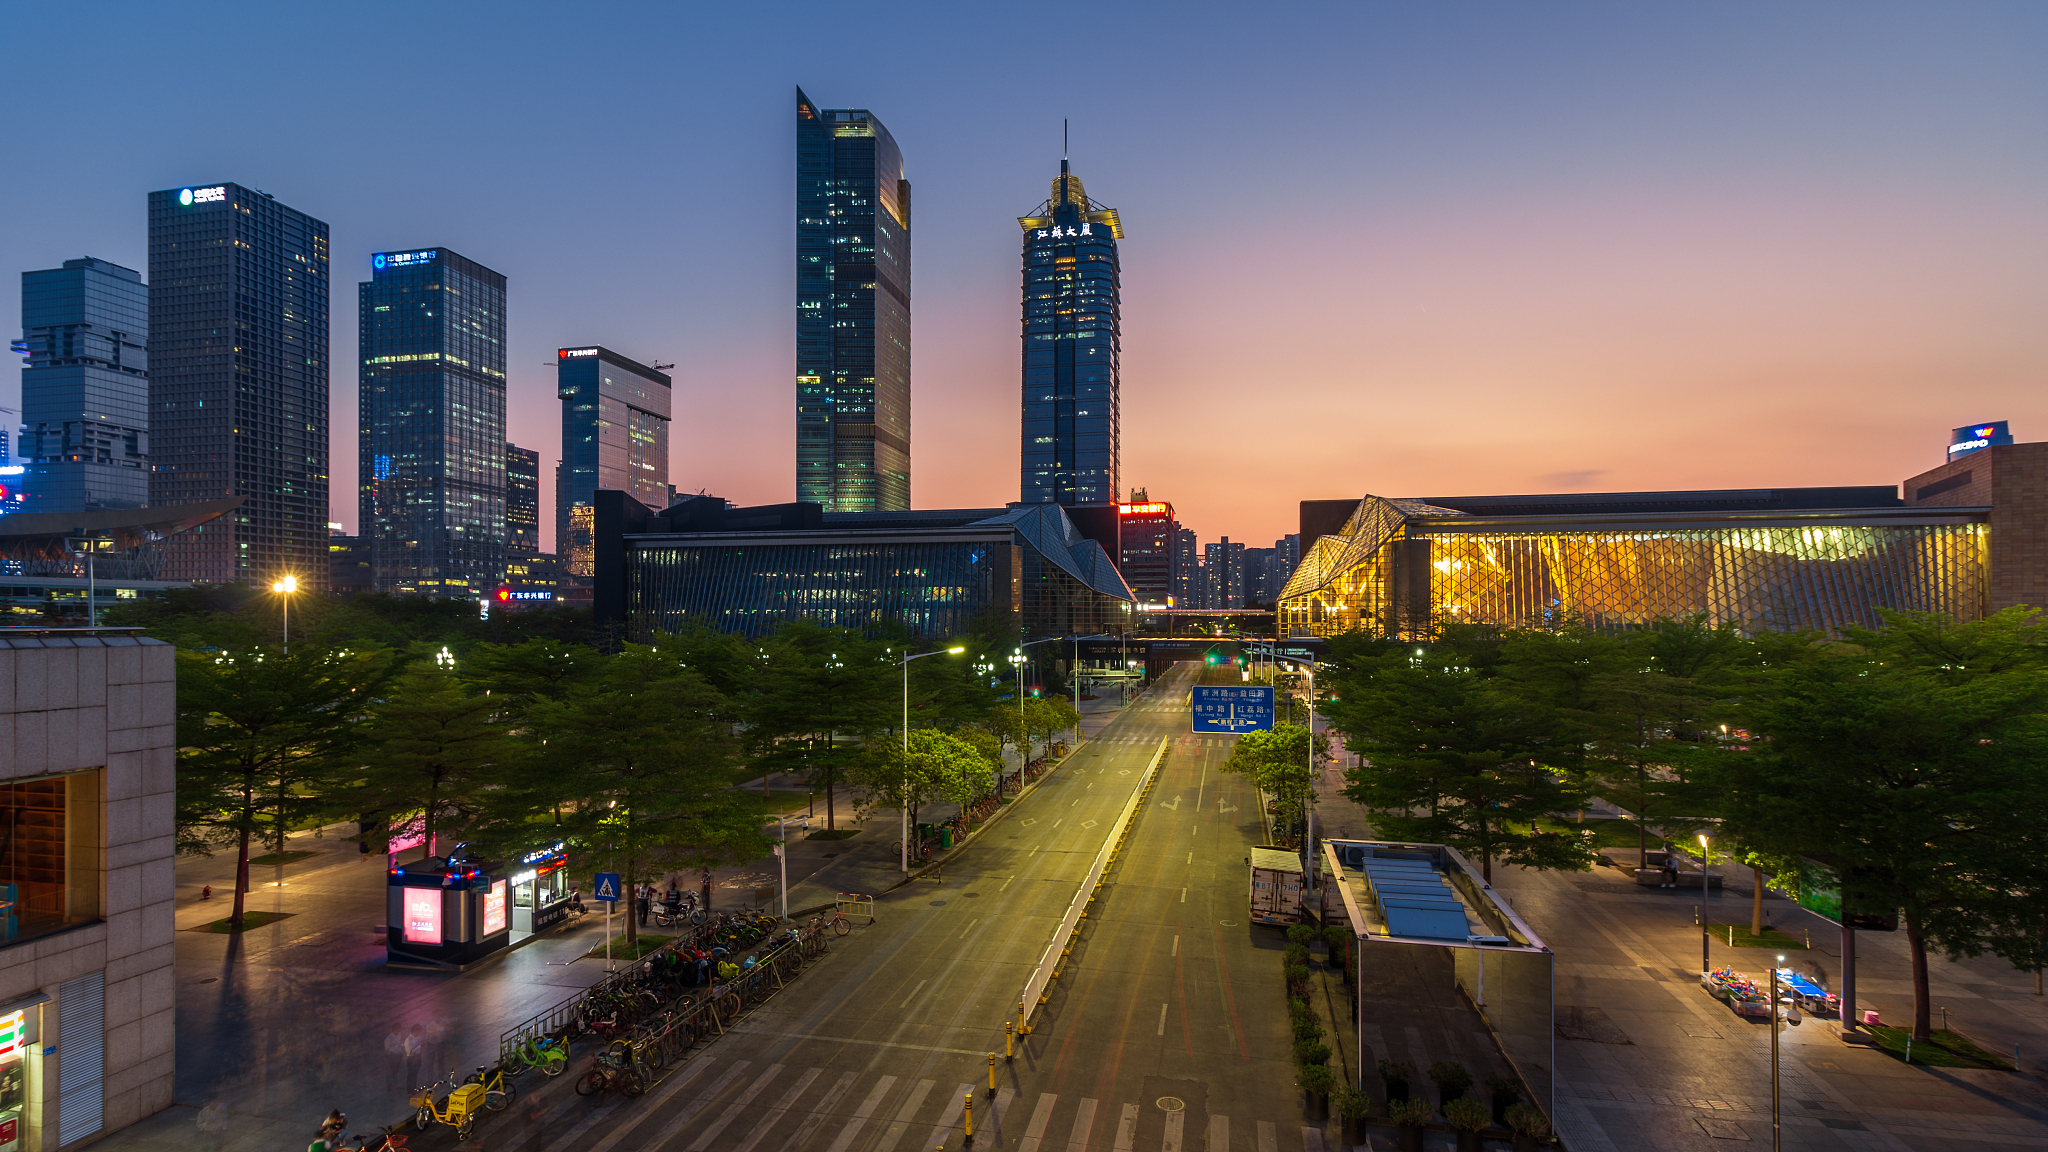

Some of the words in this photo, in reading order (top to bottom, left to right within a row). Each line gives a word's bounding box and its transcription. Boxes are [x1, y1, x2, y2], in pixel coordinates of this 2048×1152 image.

[1132, 503, 1166, 513] 平安银行
[509, 591, 551, 600] 广东华兴银行
[1195, 705, 1225, 713] 福中路
